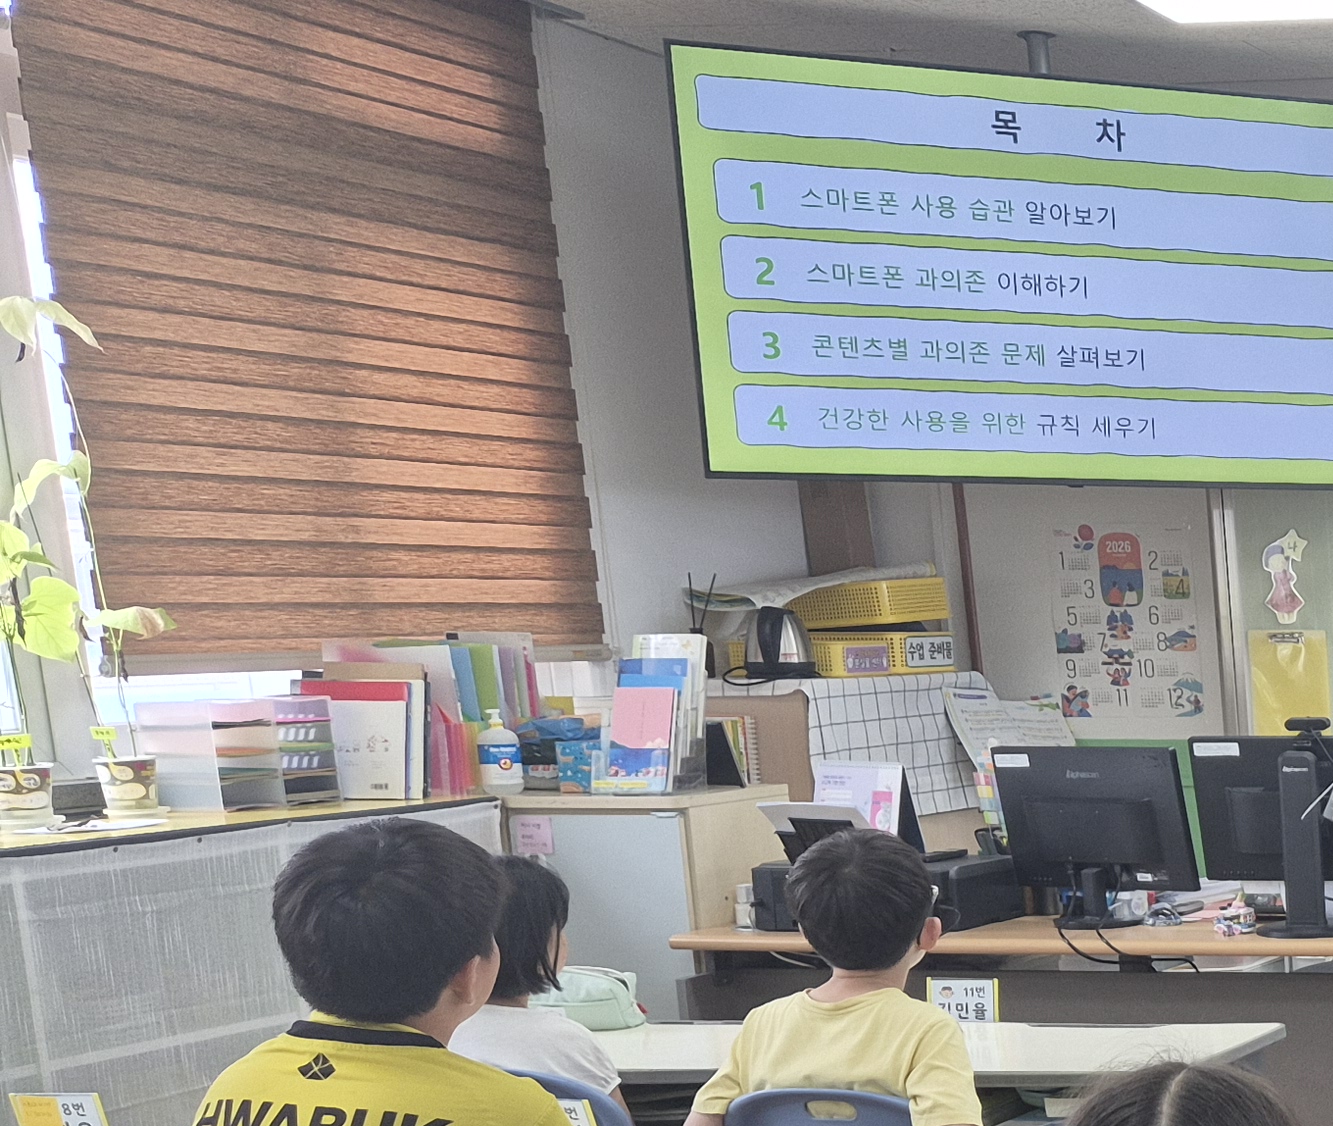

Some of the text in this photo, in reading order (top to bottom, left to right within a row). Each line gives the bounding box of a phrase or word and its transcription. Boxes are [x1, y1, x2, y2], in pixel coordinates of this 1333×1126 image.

[991, 109, 1127, 153] 목 차
[749, 182, 1118, 231] 1 스마트폰 사용 습관 알아보기
[755, 257, 1090, 301] 2 스마트폰 과의존 이해하기
[761, 332, 1146, 372] 3 콘텐츠별 과의존 문제 살펴보기
[766, 405, 1157, 440] 4 건강한 사용을 위한 규칙 세우기
[1106, 541, 1131, 553] 2026
[1059, 552, 1065, 570] 1
[1148, 551, 1158, 570] 2
[1084, 579, 1095, 599] 3
[1175, 579, 1185, 597] 4
[1067, 606, 1078, 626] 5
[1149, 606, 1159, 625] 6
[908, 641, 925, 661] 수업
[928, 641, 953, 660] 준비물
[1157, 632, 1168, 652] 8
[1066, 659, 1077, 679] 9
[1137, 659, 1155, 679] 10
[1117, 689, 1129, 707] 11
[1167, 688, 1185, 710] 12
[963, 986, 985, 998] 11번
[62, 1102, 86, 1117] 8번
